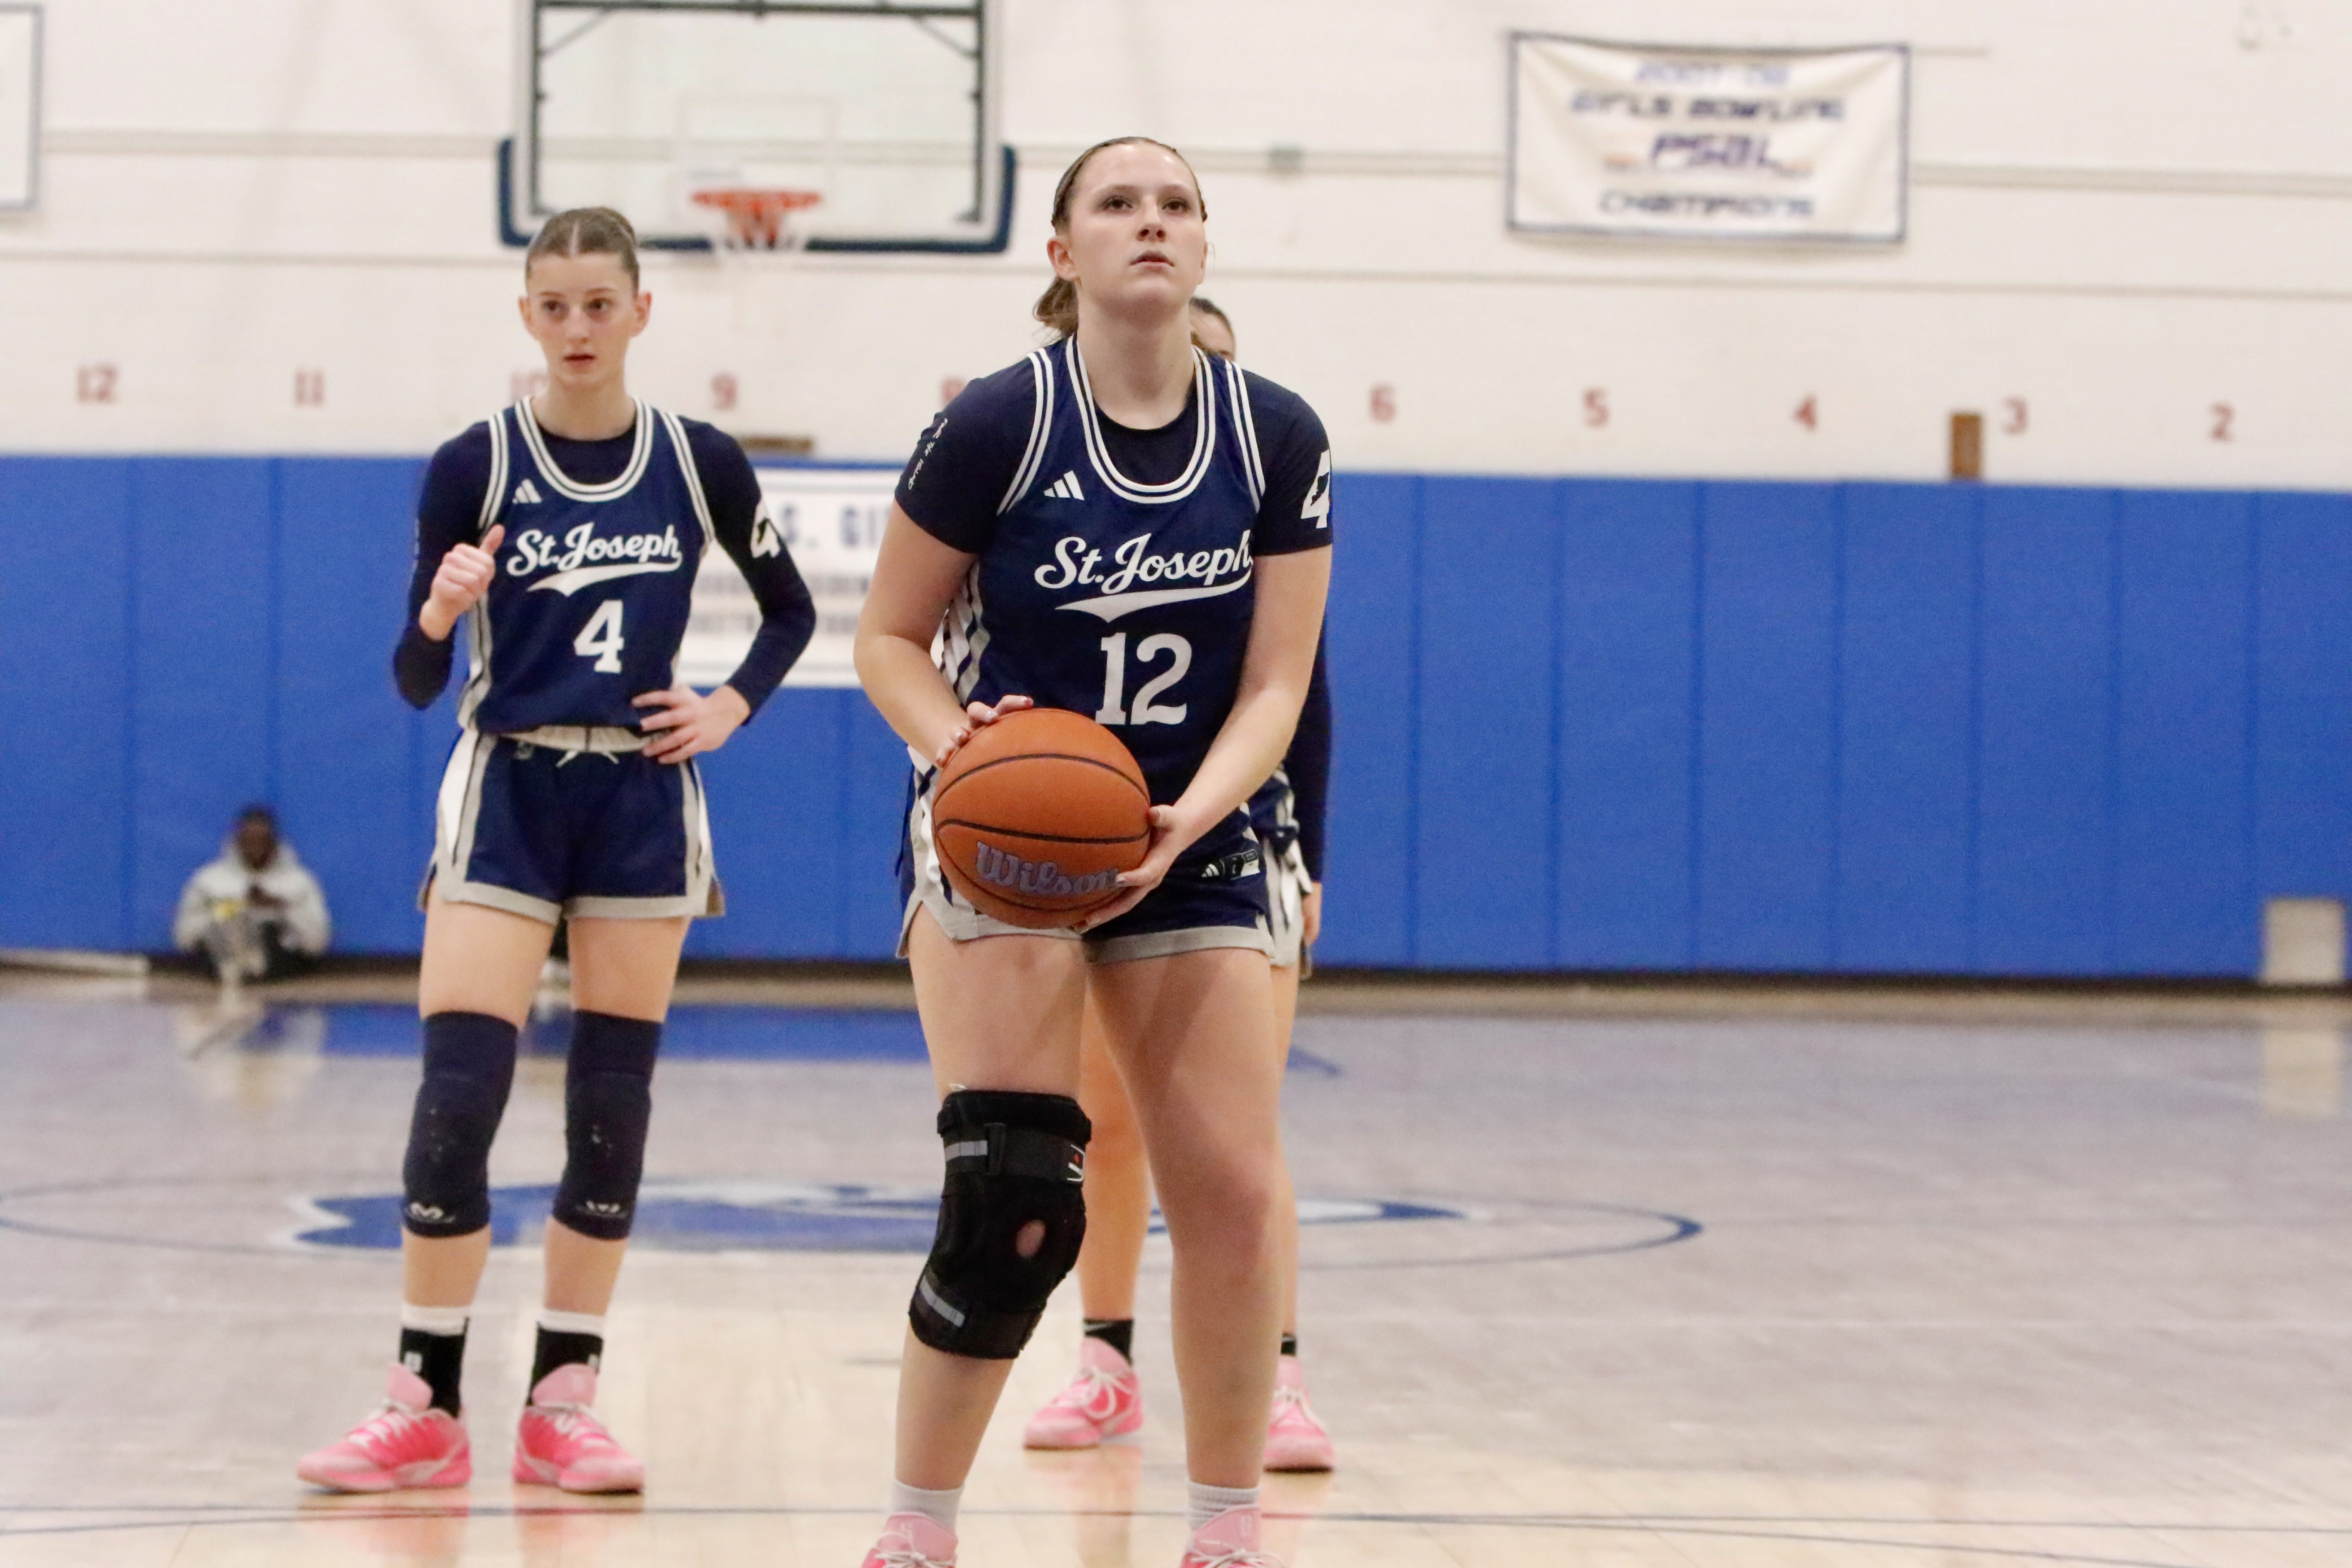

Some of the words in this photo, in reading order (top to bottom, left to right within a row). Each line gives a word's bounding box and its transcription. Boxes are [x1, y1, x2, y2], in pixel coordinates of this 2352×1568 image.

[77, 365, 118, 405] 12
[293, 368, 327, 407] 11
[712, 373, 738, 410] 9
[1368, 385, 1396, 423] 6
[1583, 388, 1609, 426] 5
[1794, 396, 1817, 432] 4
[2004, 398, 2029, 434] 3
[2210, 403, 2235, 441] 2
[573, 599, 624, 674] 4
[1095, 632, 1192, 725] 12
[976, 841, 1119, 895] Wilson
